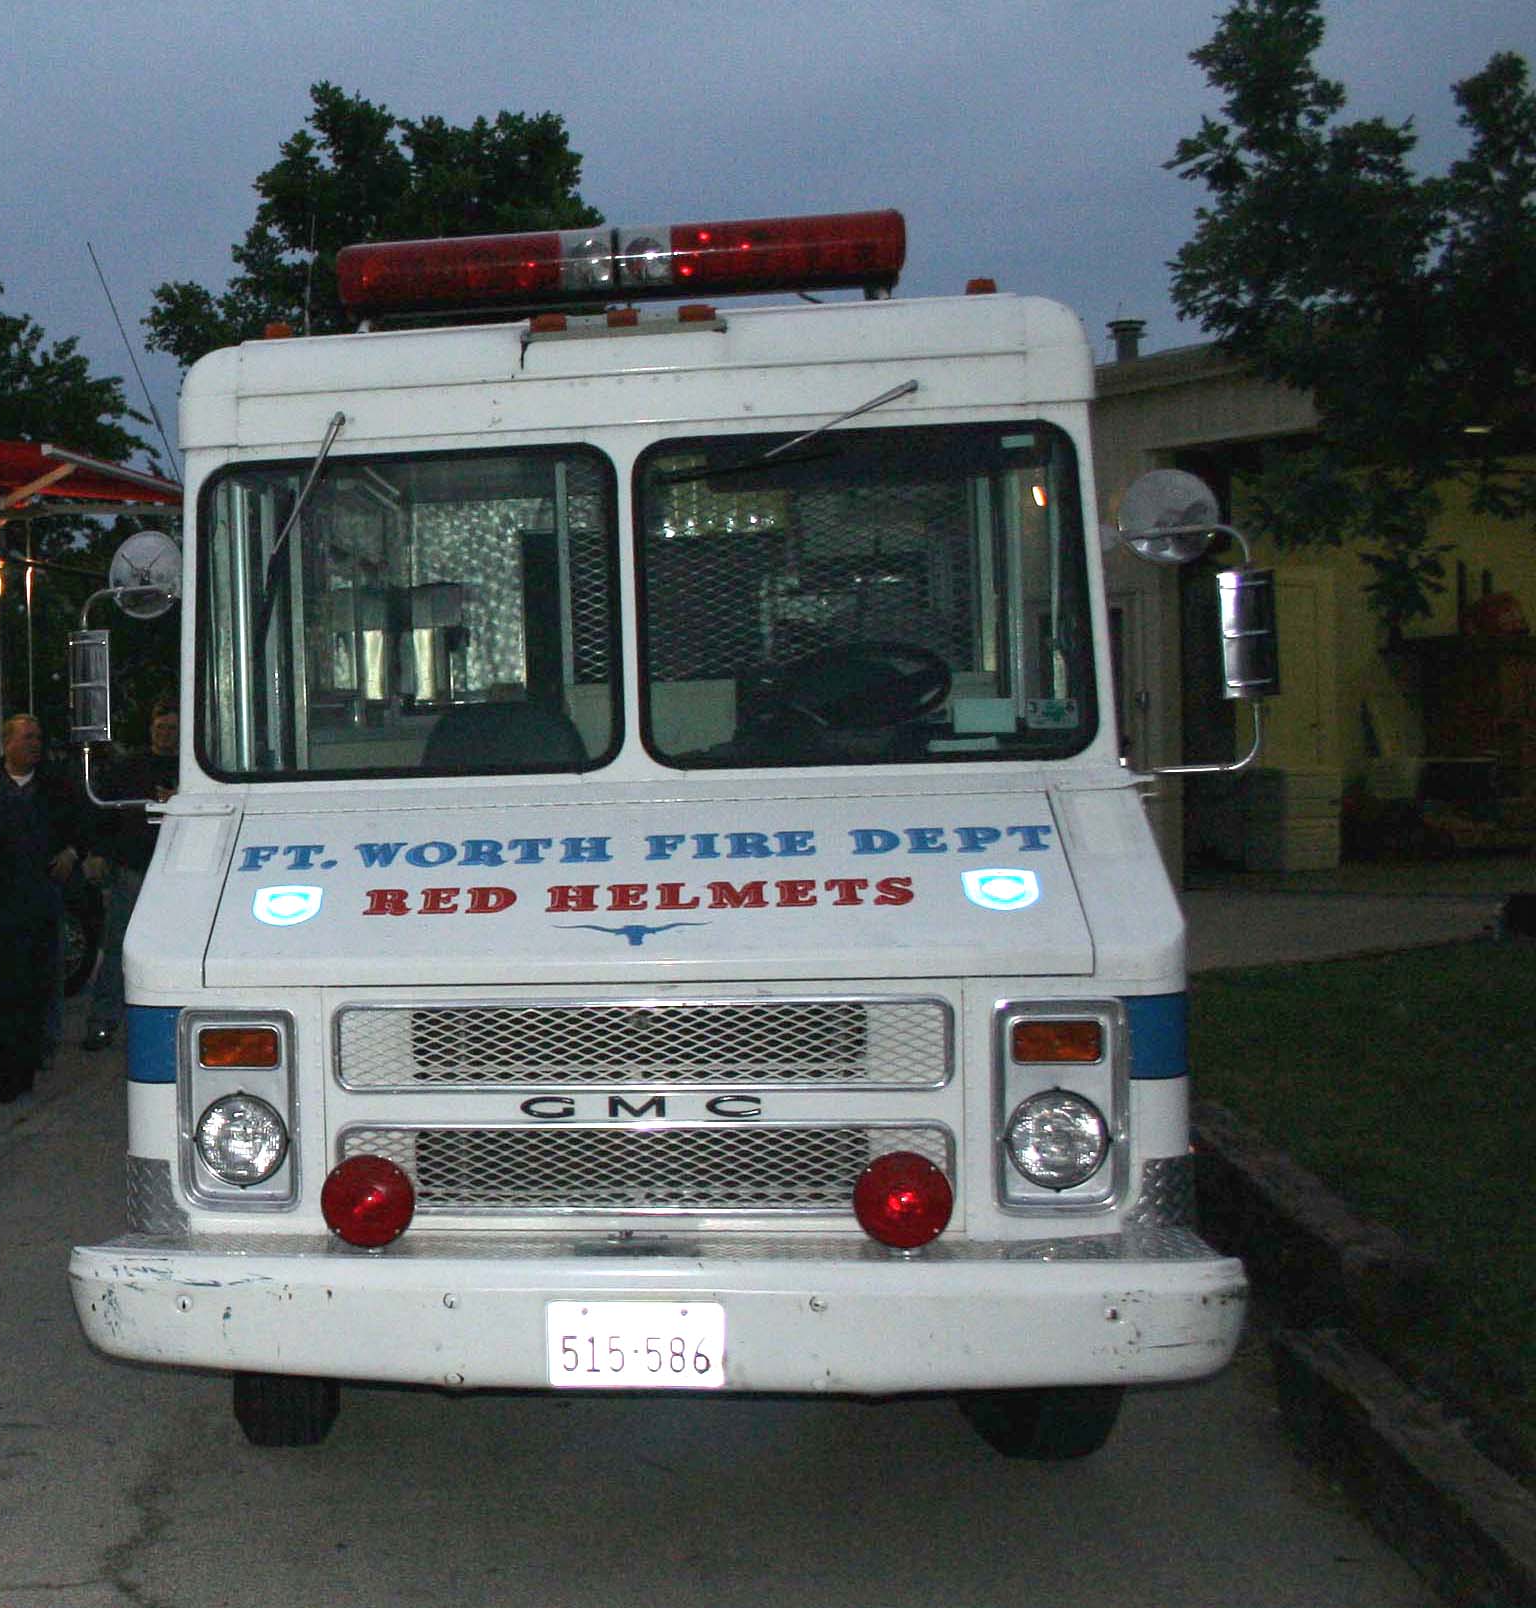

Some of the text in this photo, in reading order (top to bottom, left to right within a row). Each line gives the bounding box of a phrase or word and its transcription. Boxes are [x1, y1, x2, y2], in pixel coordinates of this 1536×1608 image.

[237, 824, 1052, 872] FT. WORTH FIRE DEPT
[362, 876, 915, 916] RED HELMETS
[520, 1094, 761, 1119] GMC
